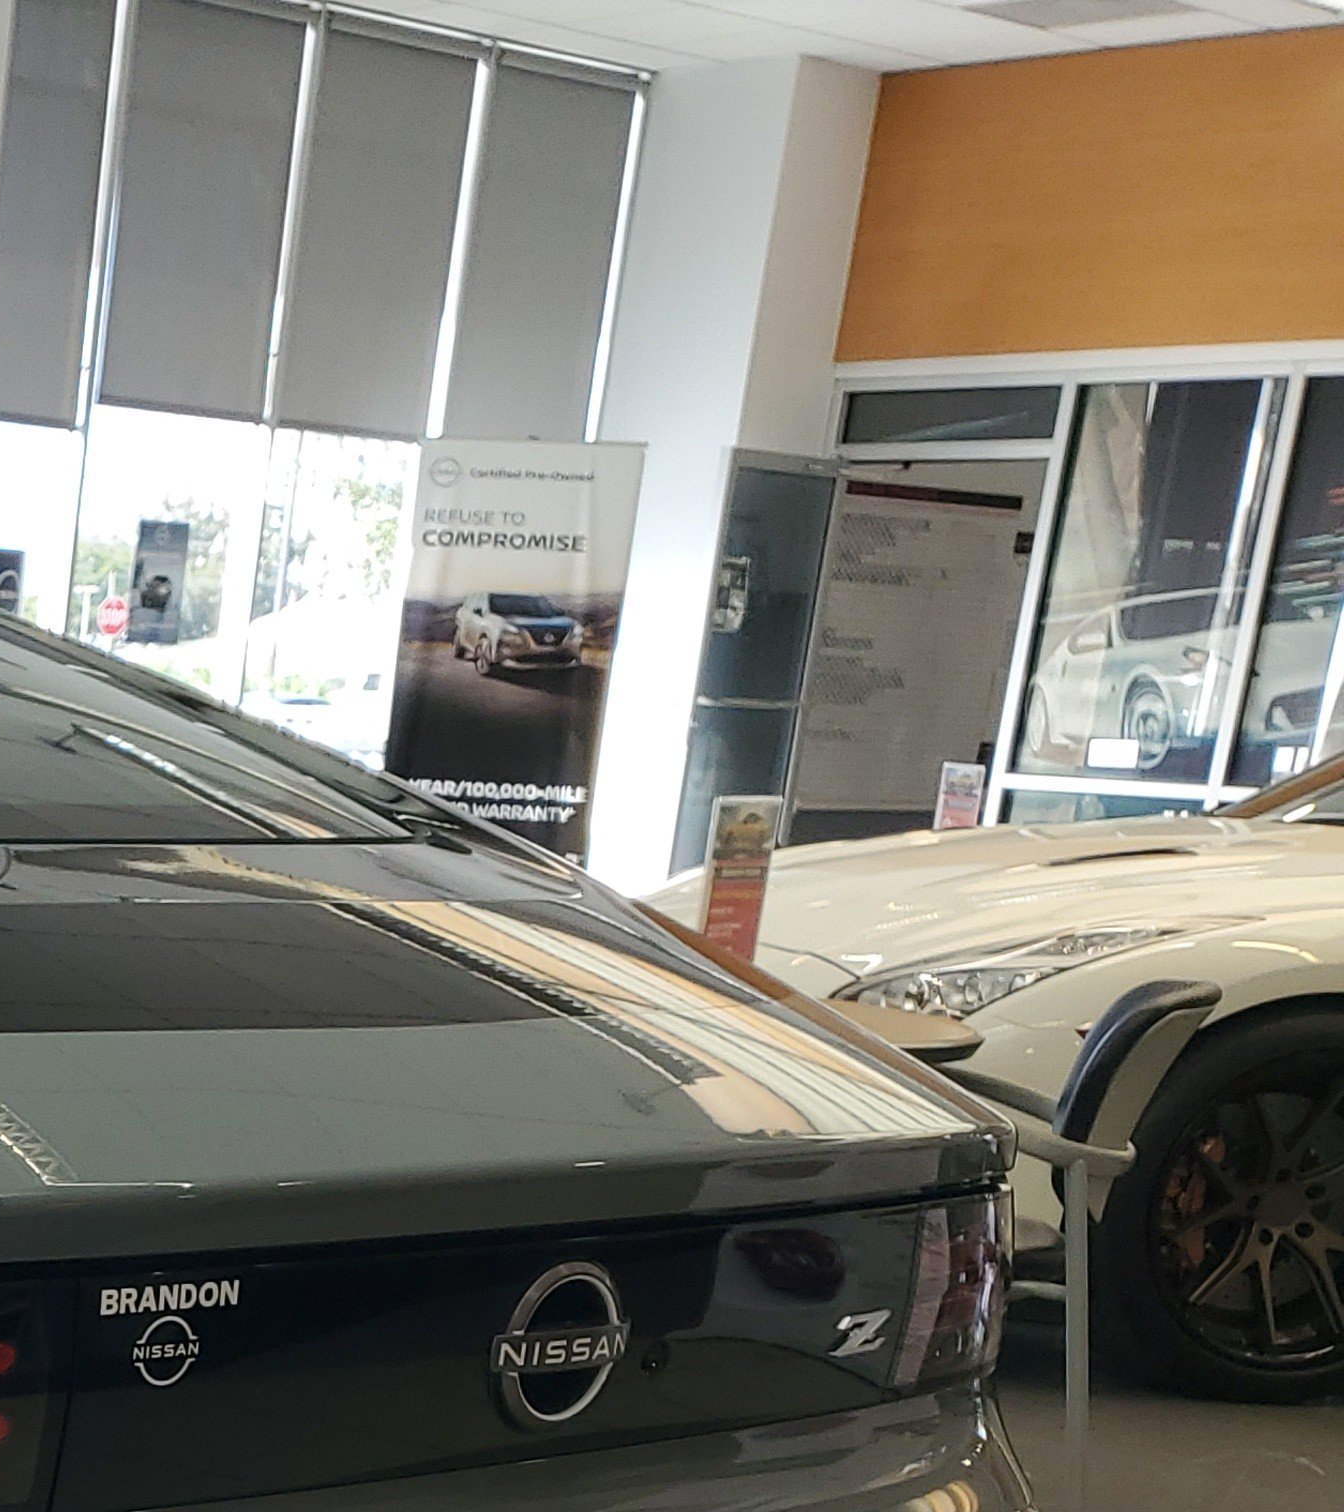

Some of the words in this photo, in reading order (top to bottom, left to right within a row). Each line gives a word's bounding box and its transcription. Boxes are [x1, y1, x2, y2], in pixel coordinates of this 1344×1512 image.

[424, 508, 495, 525] REFUSE
[502, 510, 526, 525] TO
[422, 528, 587, 552] COMPROMISE
[100, 1279, 240, 1316] BRANDON
[828, 1309, 892, 1357] Z
[133, 1341, 199, 1360] NISSAN
[498, 1332, 627, 1366] NISSAN
